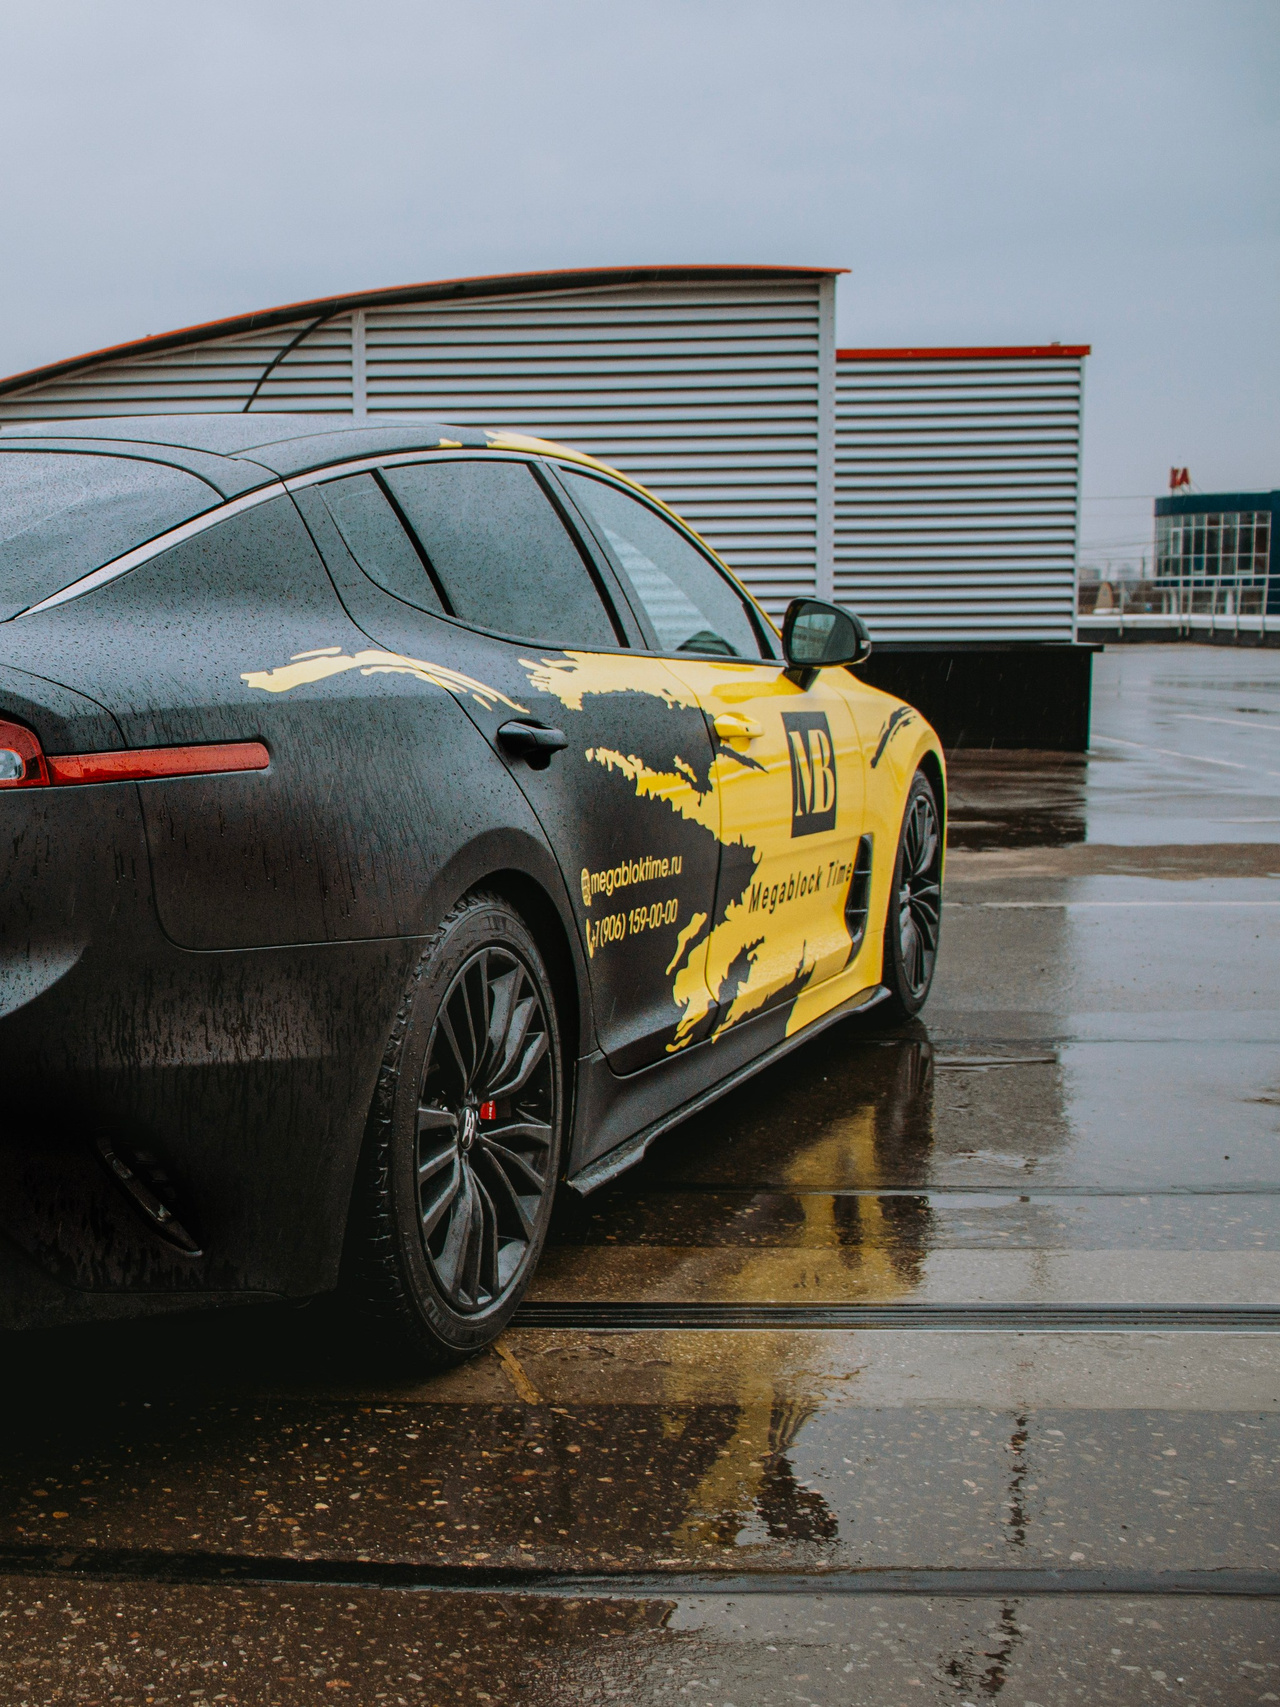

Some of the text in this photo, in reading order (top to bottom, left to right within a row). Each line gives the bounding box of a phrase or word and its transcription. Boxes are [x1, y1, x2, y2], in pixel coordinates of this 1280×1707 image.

[788, 729, 835, 817] MB
[590, 855, 683, 897] megabloktime.ru
[748, 860, 853, 915] Megablock Time
[628, 898, 679, 935] 159-00-00
